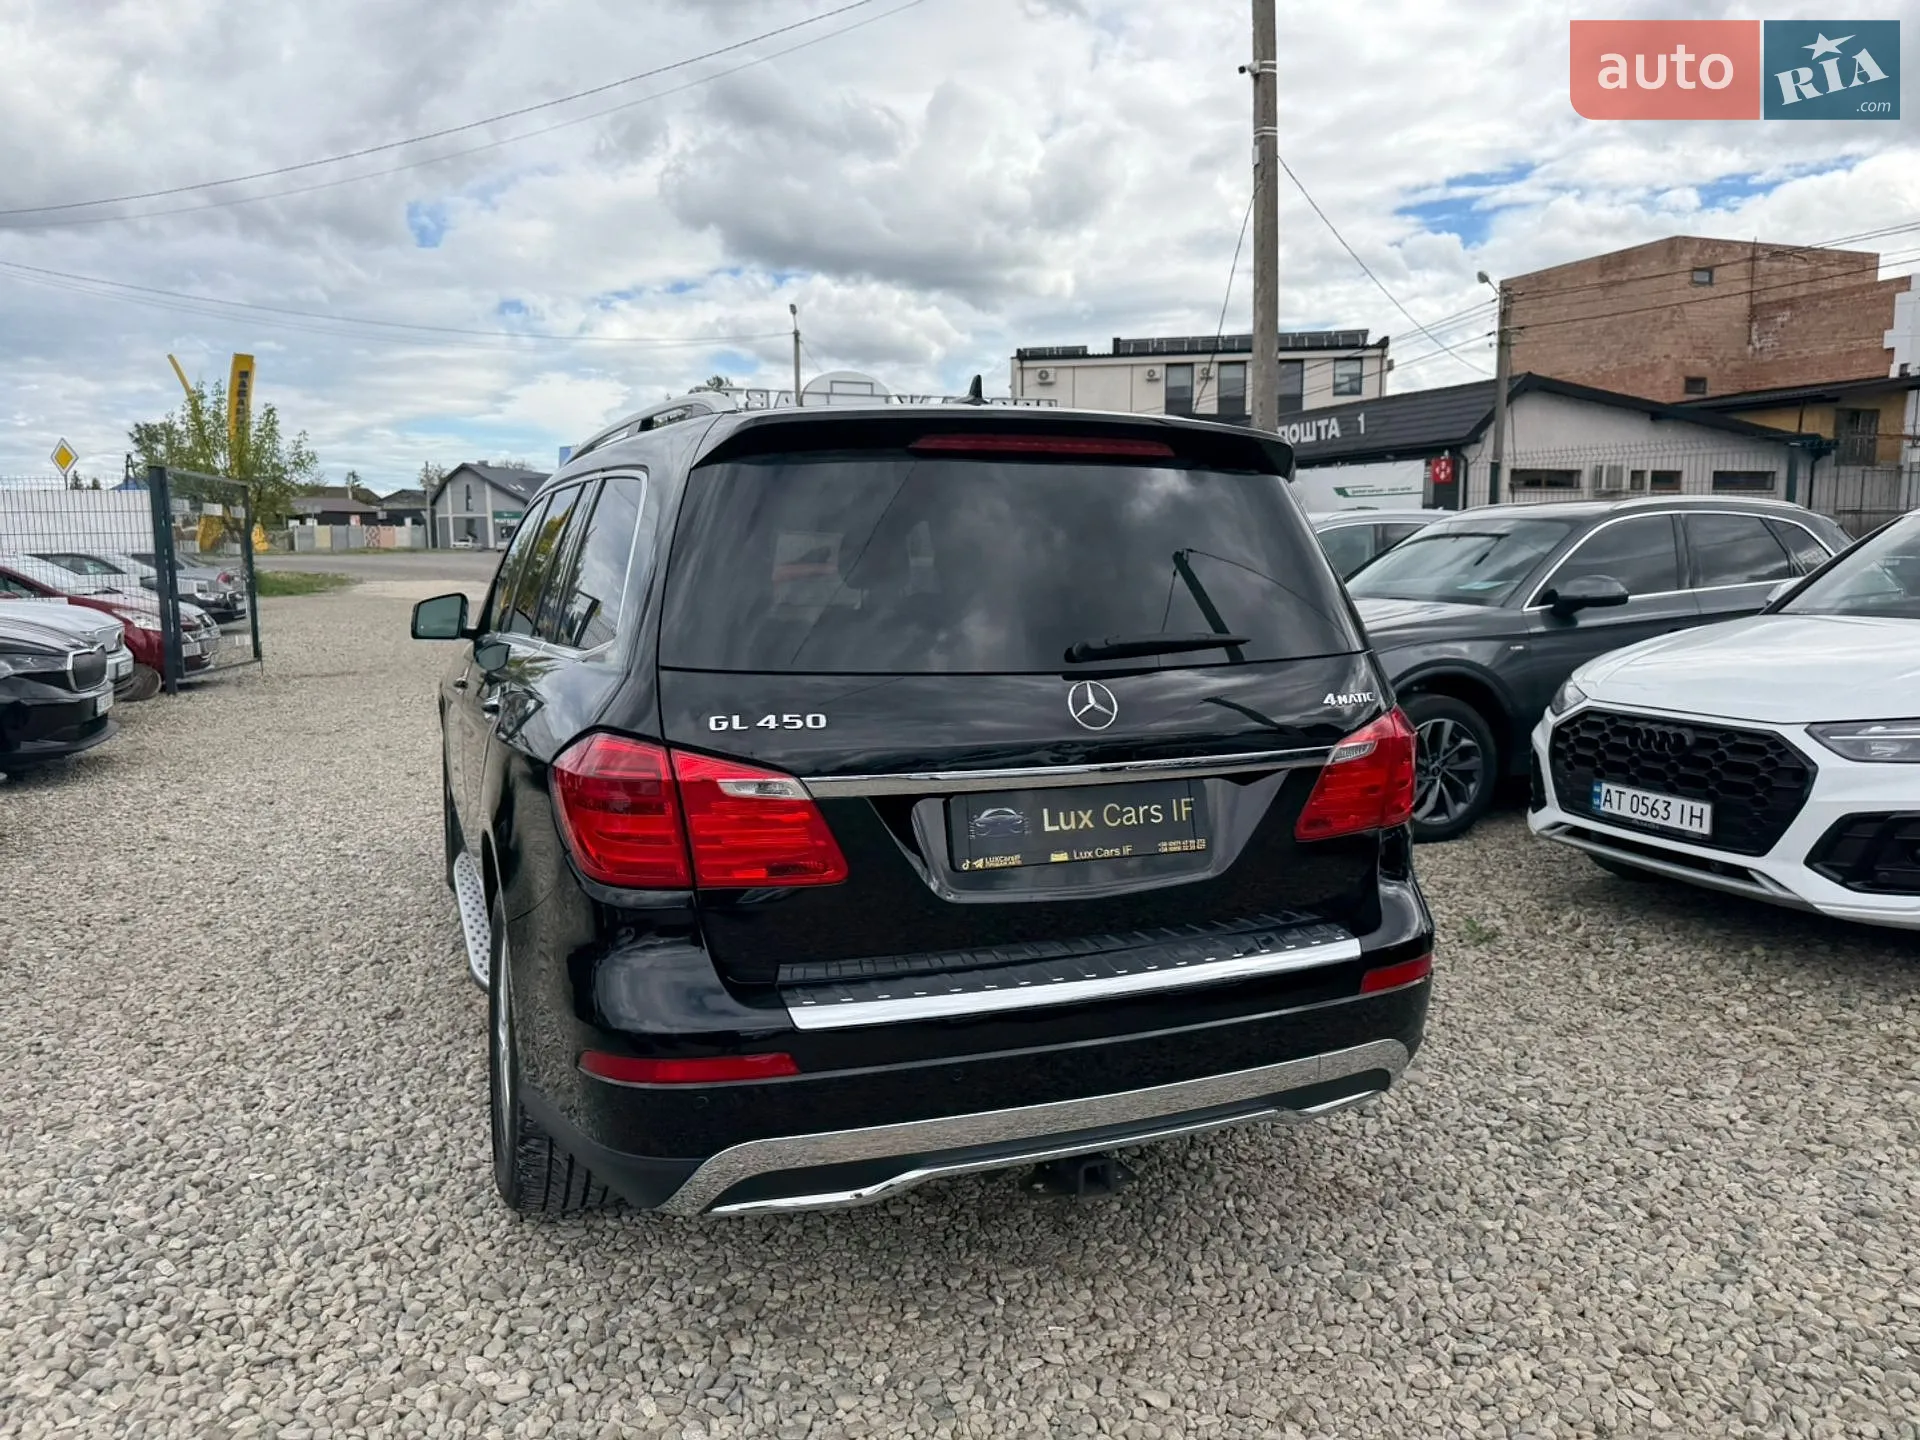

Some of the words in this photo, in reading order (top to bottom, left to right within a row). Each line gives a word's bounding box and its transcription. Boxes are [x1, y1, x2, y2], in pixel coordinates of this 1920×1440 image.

[1277, 417, 1341, 444] ПОШТА
[1357, 412, 1366, 435] 1
[1323, 691, 1376, 706] 4MATIC
[708, 715, 749, 731] GL
[756, 713, 827, 730] 450
[1042, 807, 1094, 832] Lux
[1102, 802, 1163, 828] Cars
[1172, 797, 1195, 822] IF
[1603, 788, 1627, 811] AT
[1630, 794, 1672, 821] 0563
[1679, 804, 1704, 829] IH
[1073, 849, 1094, 861] Lux
[1094, 846, 1120, 858] Cars
[1122, 845, 1133, 856] IF
